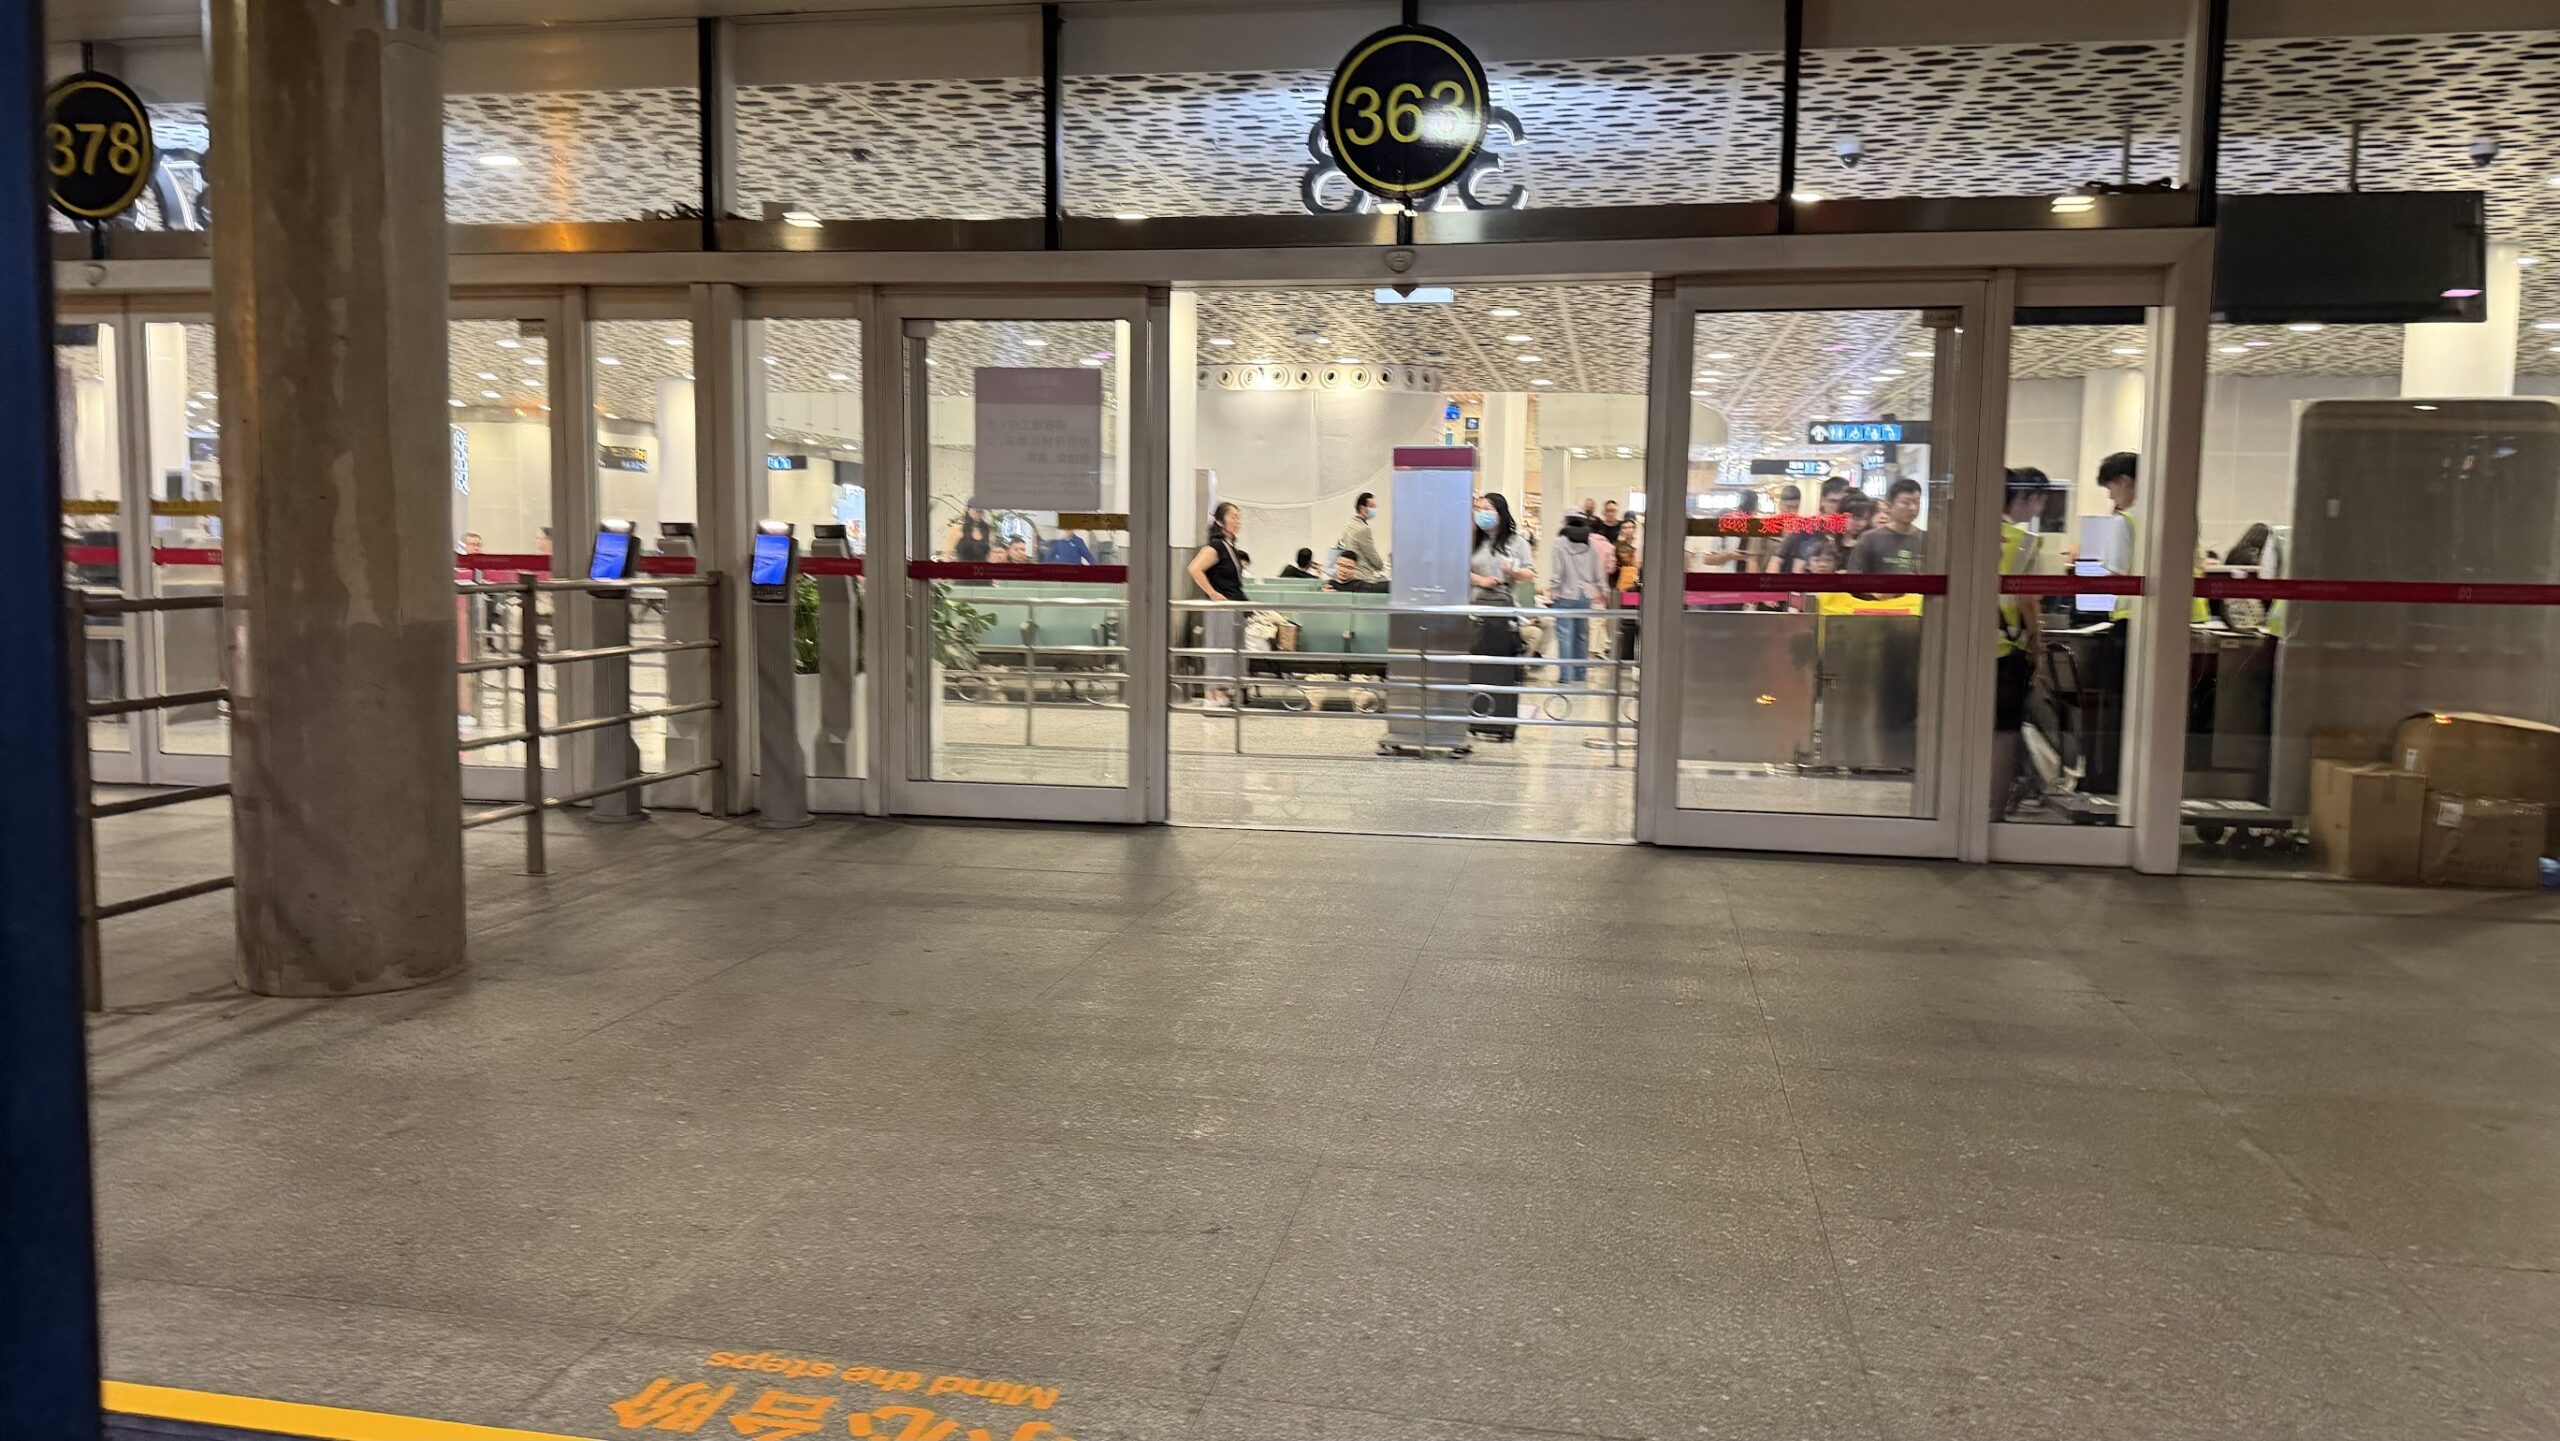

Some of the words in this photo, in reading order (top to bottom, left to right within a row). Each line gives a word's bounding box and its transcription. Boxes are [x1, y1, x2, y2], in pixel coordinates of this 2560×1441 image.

[1345, 80, 1469, 146] 363
[48, 122, 140, 176] 378
[705, 1350, 837, 1378] steps
[841, 1366, 923, 1392] the
[927, 1375, 1061, 1409] Mind
